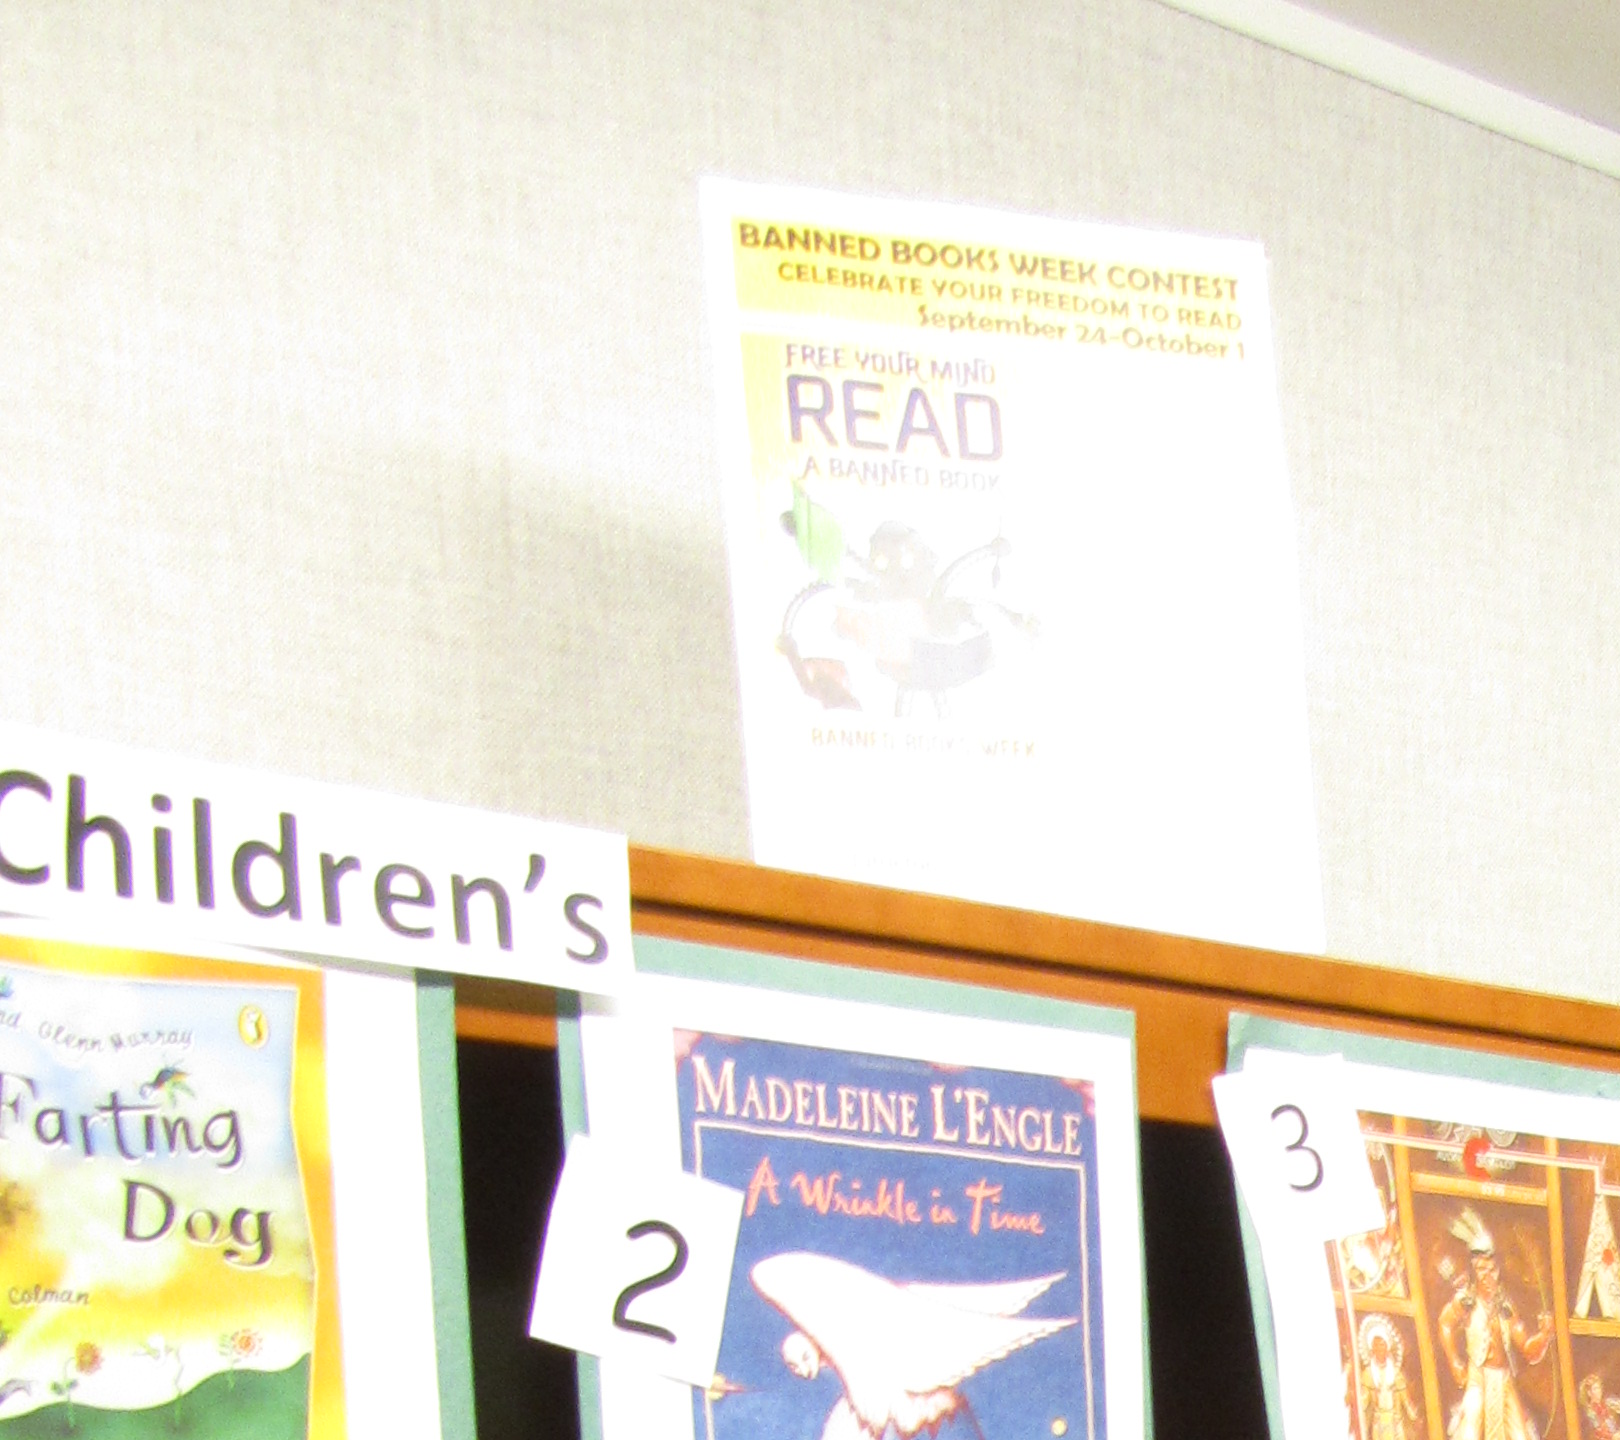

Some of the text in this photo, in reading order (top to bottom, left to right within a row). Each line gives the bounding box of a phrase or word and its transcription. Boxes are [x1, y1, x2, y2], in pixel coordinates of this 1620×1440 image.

[739, 223, 1240, 302] BANNED BOOKS WEEK CONTEST
[778, 261, 1243, 331] CELEBRATE YOUR FREEDOM TO READ
[917, 304, 1066, 341] September
[784, 344, 997, 388] FREE YOUR MIND
[786, 373, 1004, 463] READ
[799, 455, 821, 481] A
[827, 457, 931, 488] BANNED
[0, 768, 611, 966] Children's
[38, 1020, 105, 1054] Glenn
[691, 1054, 920, 1139] MADELEINE
[1269, 1103, 1325, 1193] 3
[121, 1177, 275, 1269] Dog
[744, 1154, 1047, 1237] A Wrinkle in Time
[611, 1217, 691, 1345] 2
